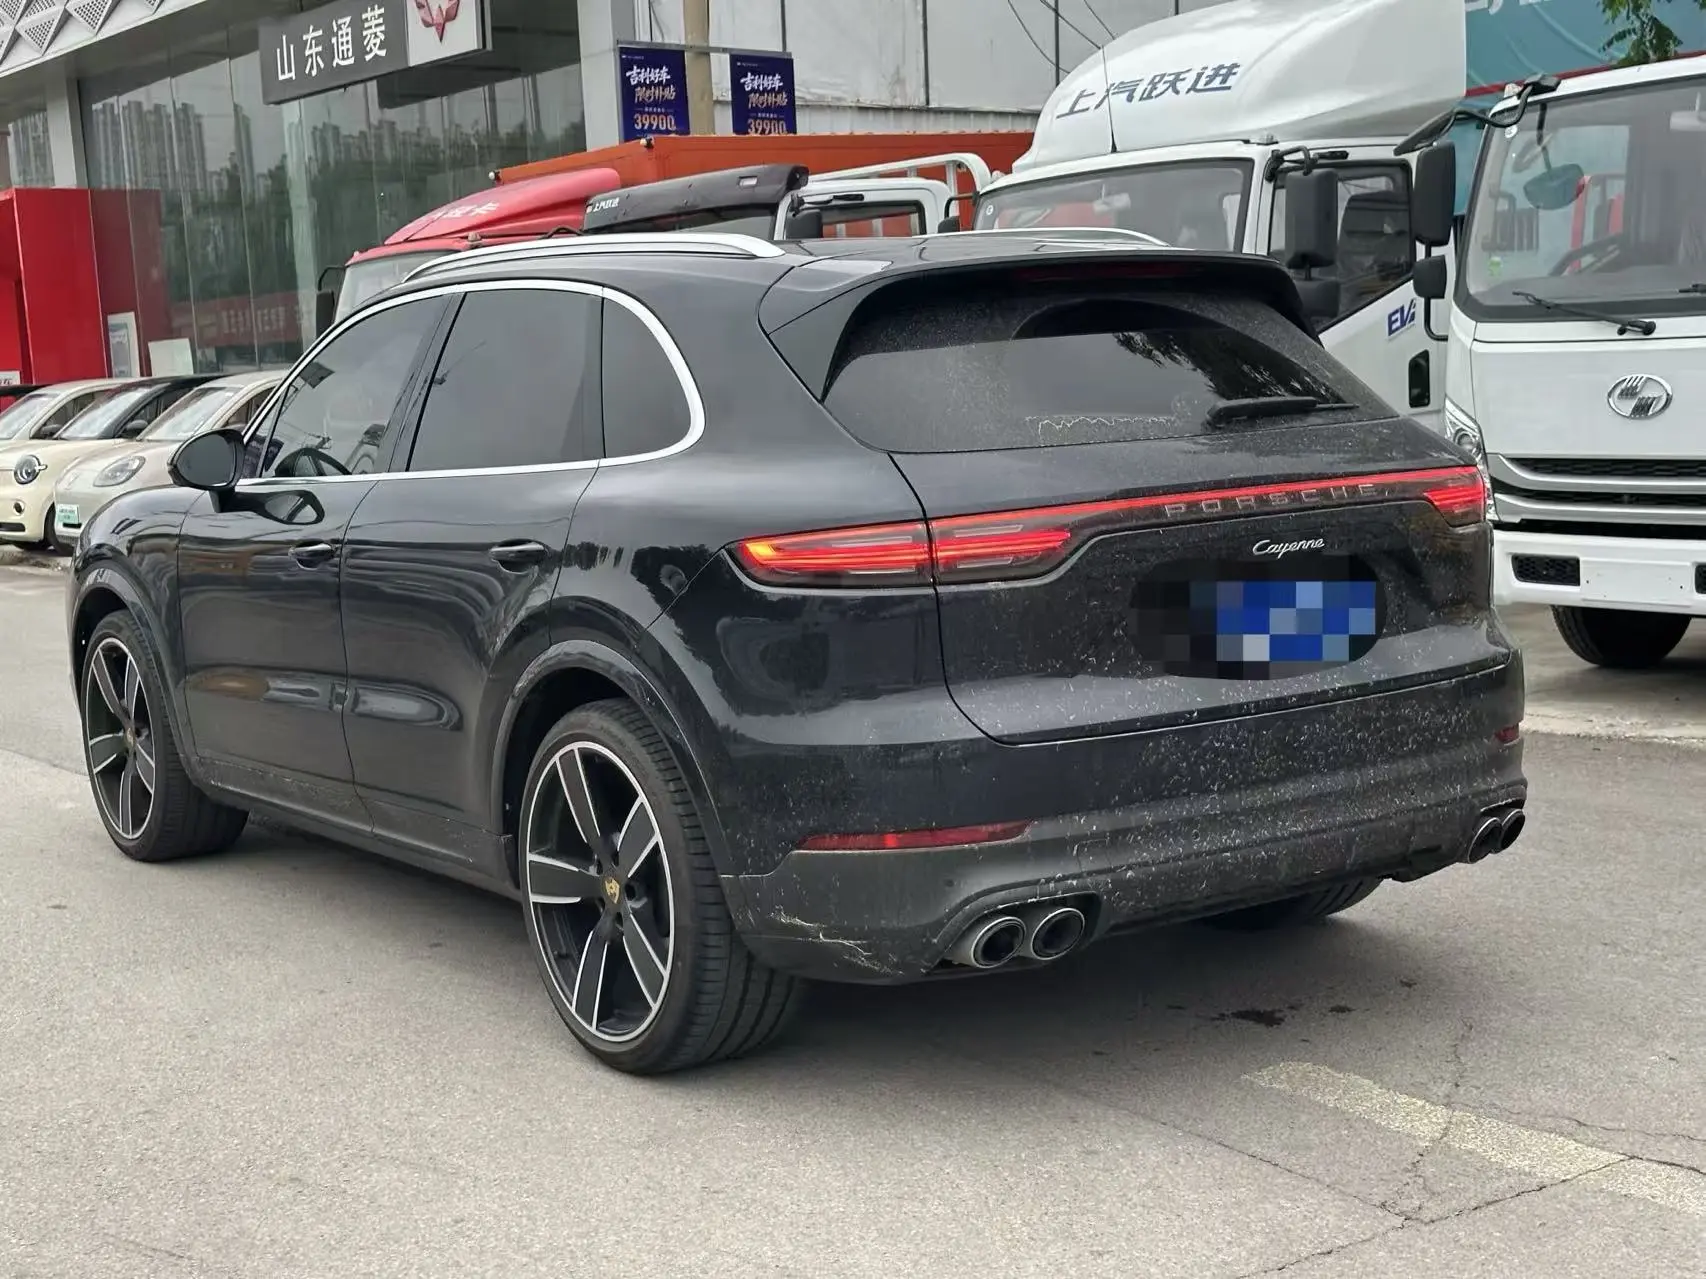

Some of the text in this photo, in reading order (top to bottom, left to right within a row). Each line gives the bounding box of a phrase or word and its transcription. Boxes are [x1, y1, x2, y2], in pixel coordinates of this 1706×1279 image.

[276, 4, 387, 81] 山东通菱
[1056, 63, 1241, 118] 上汽跃进
[633, 113, 677, 130] 39900
[1164, 483, 1375, 518] PORSCHE
[1252, 537, 1325, 559] Cayenne
